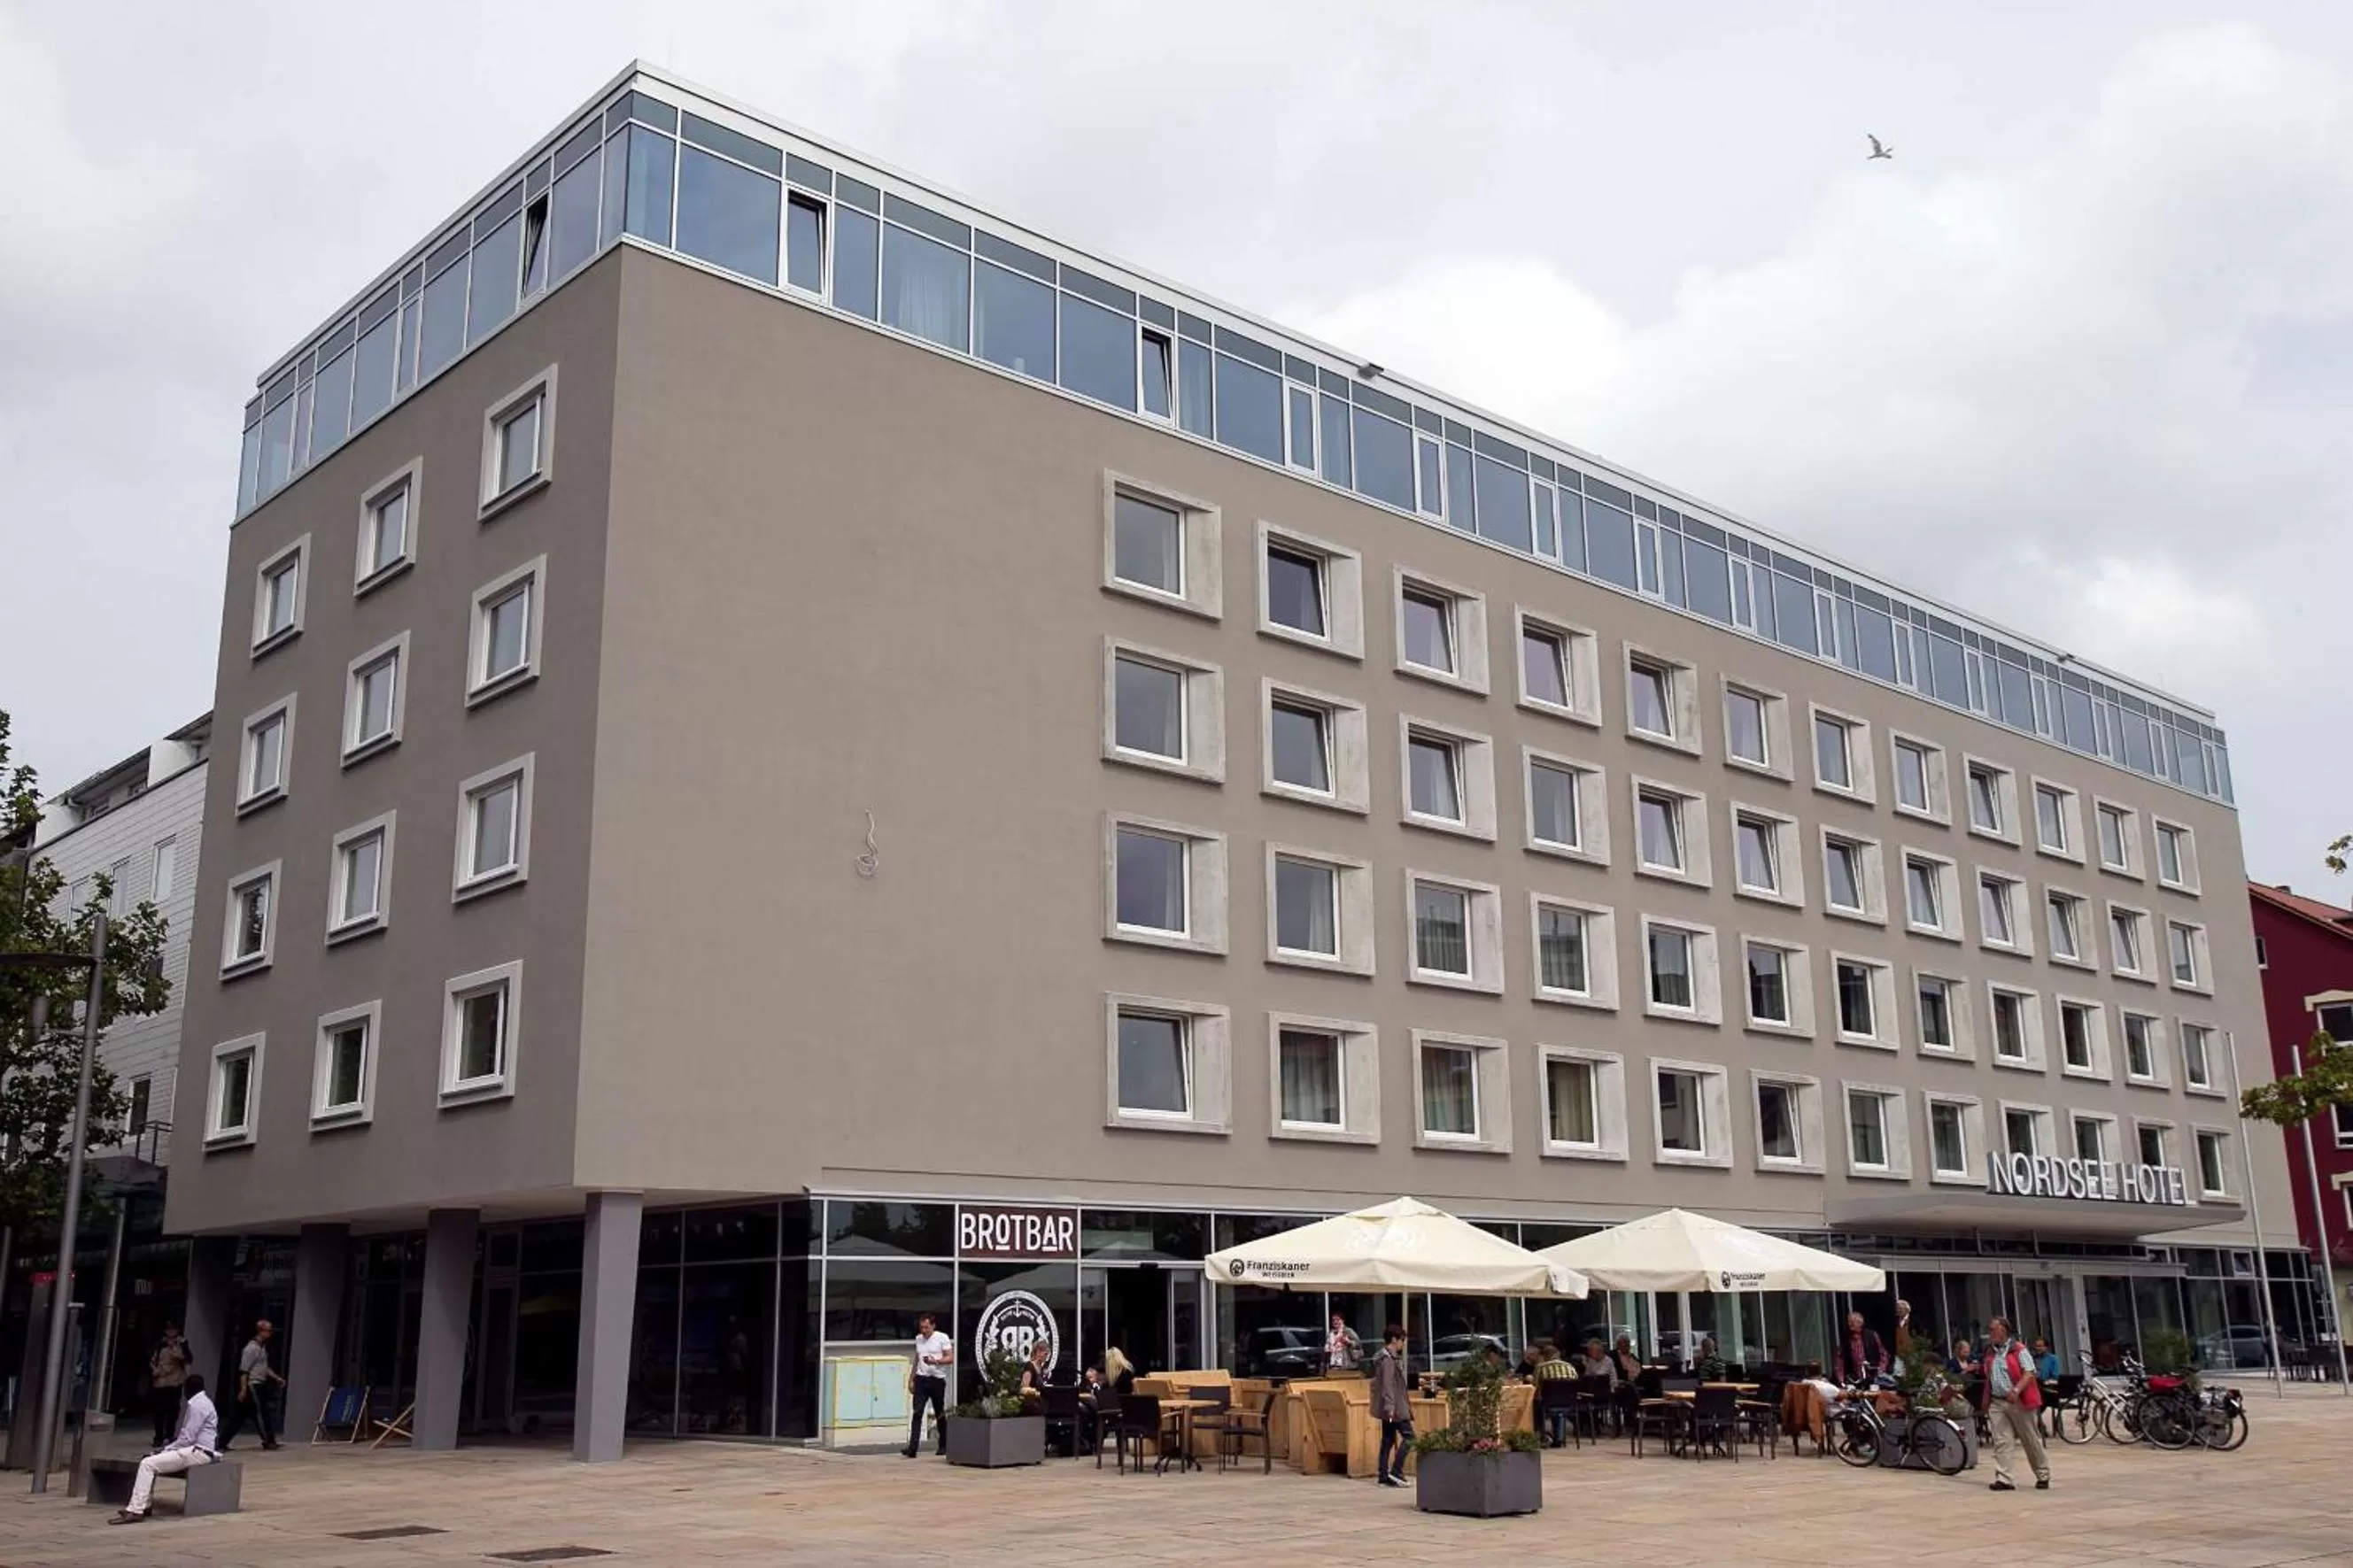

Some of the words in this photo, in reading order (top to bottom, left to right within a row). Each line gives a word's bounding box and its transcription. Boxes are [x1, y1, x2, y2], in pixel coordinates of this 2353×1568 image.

[1991, 1150, 2117, 1201] NORDSEE
[2123, 1163, 2197, 1205] HOTEL
[960, 1212, 1073, 1252] BROTBAR
[1246, 1260, 1311, 1271] Franziskaner
